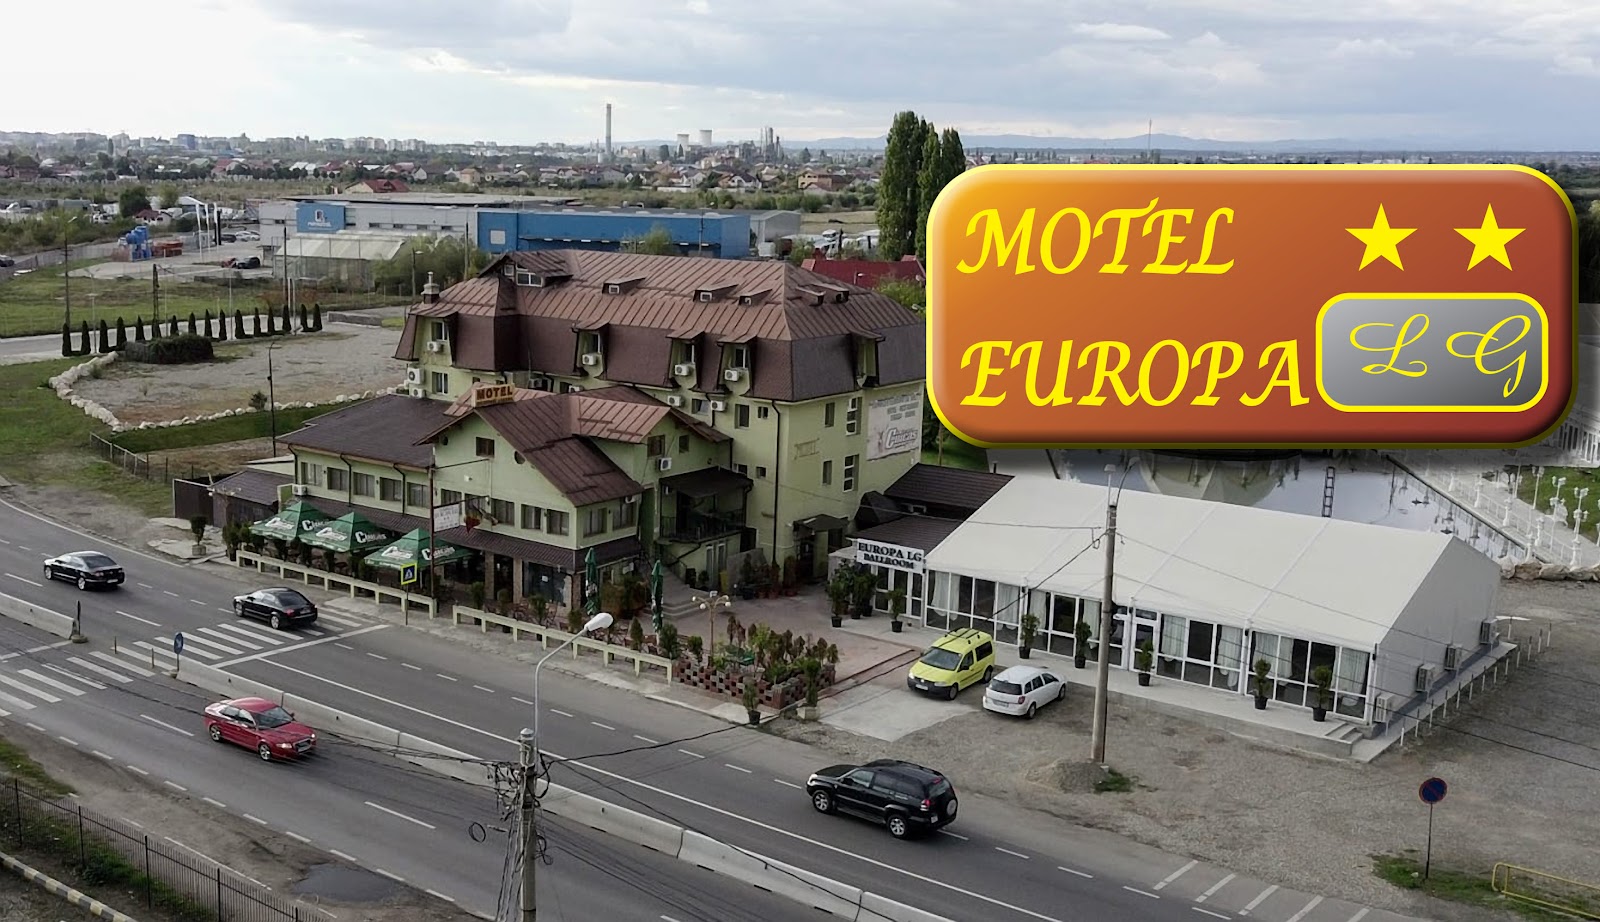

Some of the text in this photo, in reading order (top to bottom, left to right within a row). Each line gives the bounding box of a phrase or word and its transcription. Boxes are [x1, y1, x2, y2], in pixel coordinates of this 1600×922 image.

[476, 386, 513, 400] MOTEL
[858, 542, 922, 562] EUROPA LG
[863, 553, 914, 569] BALLROOM
